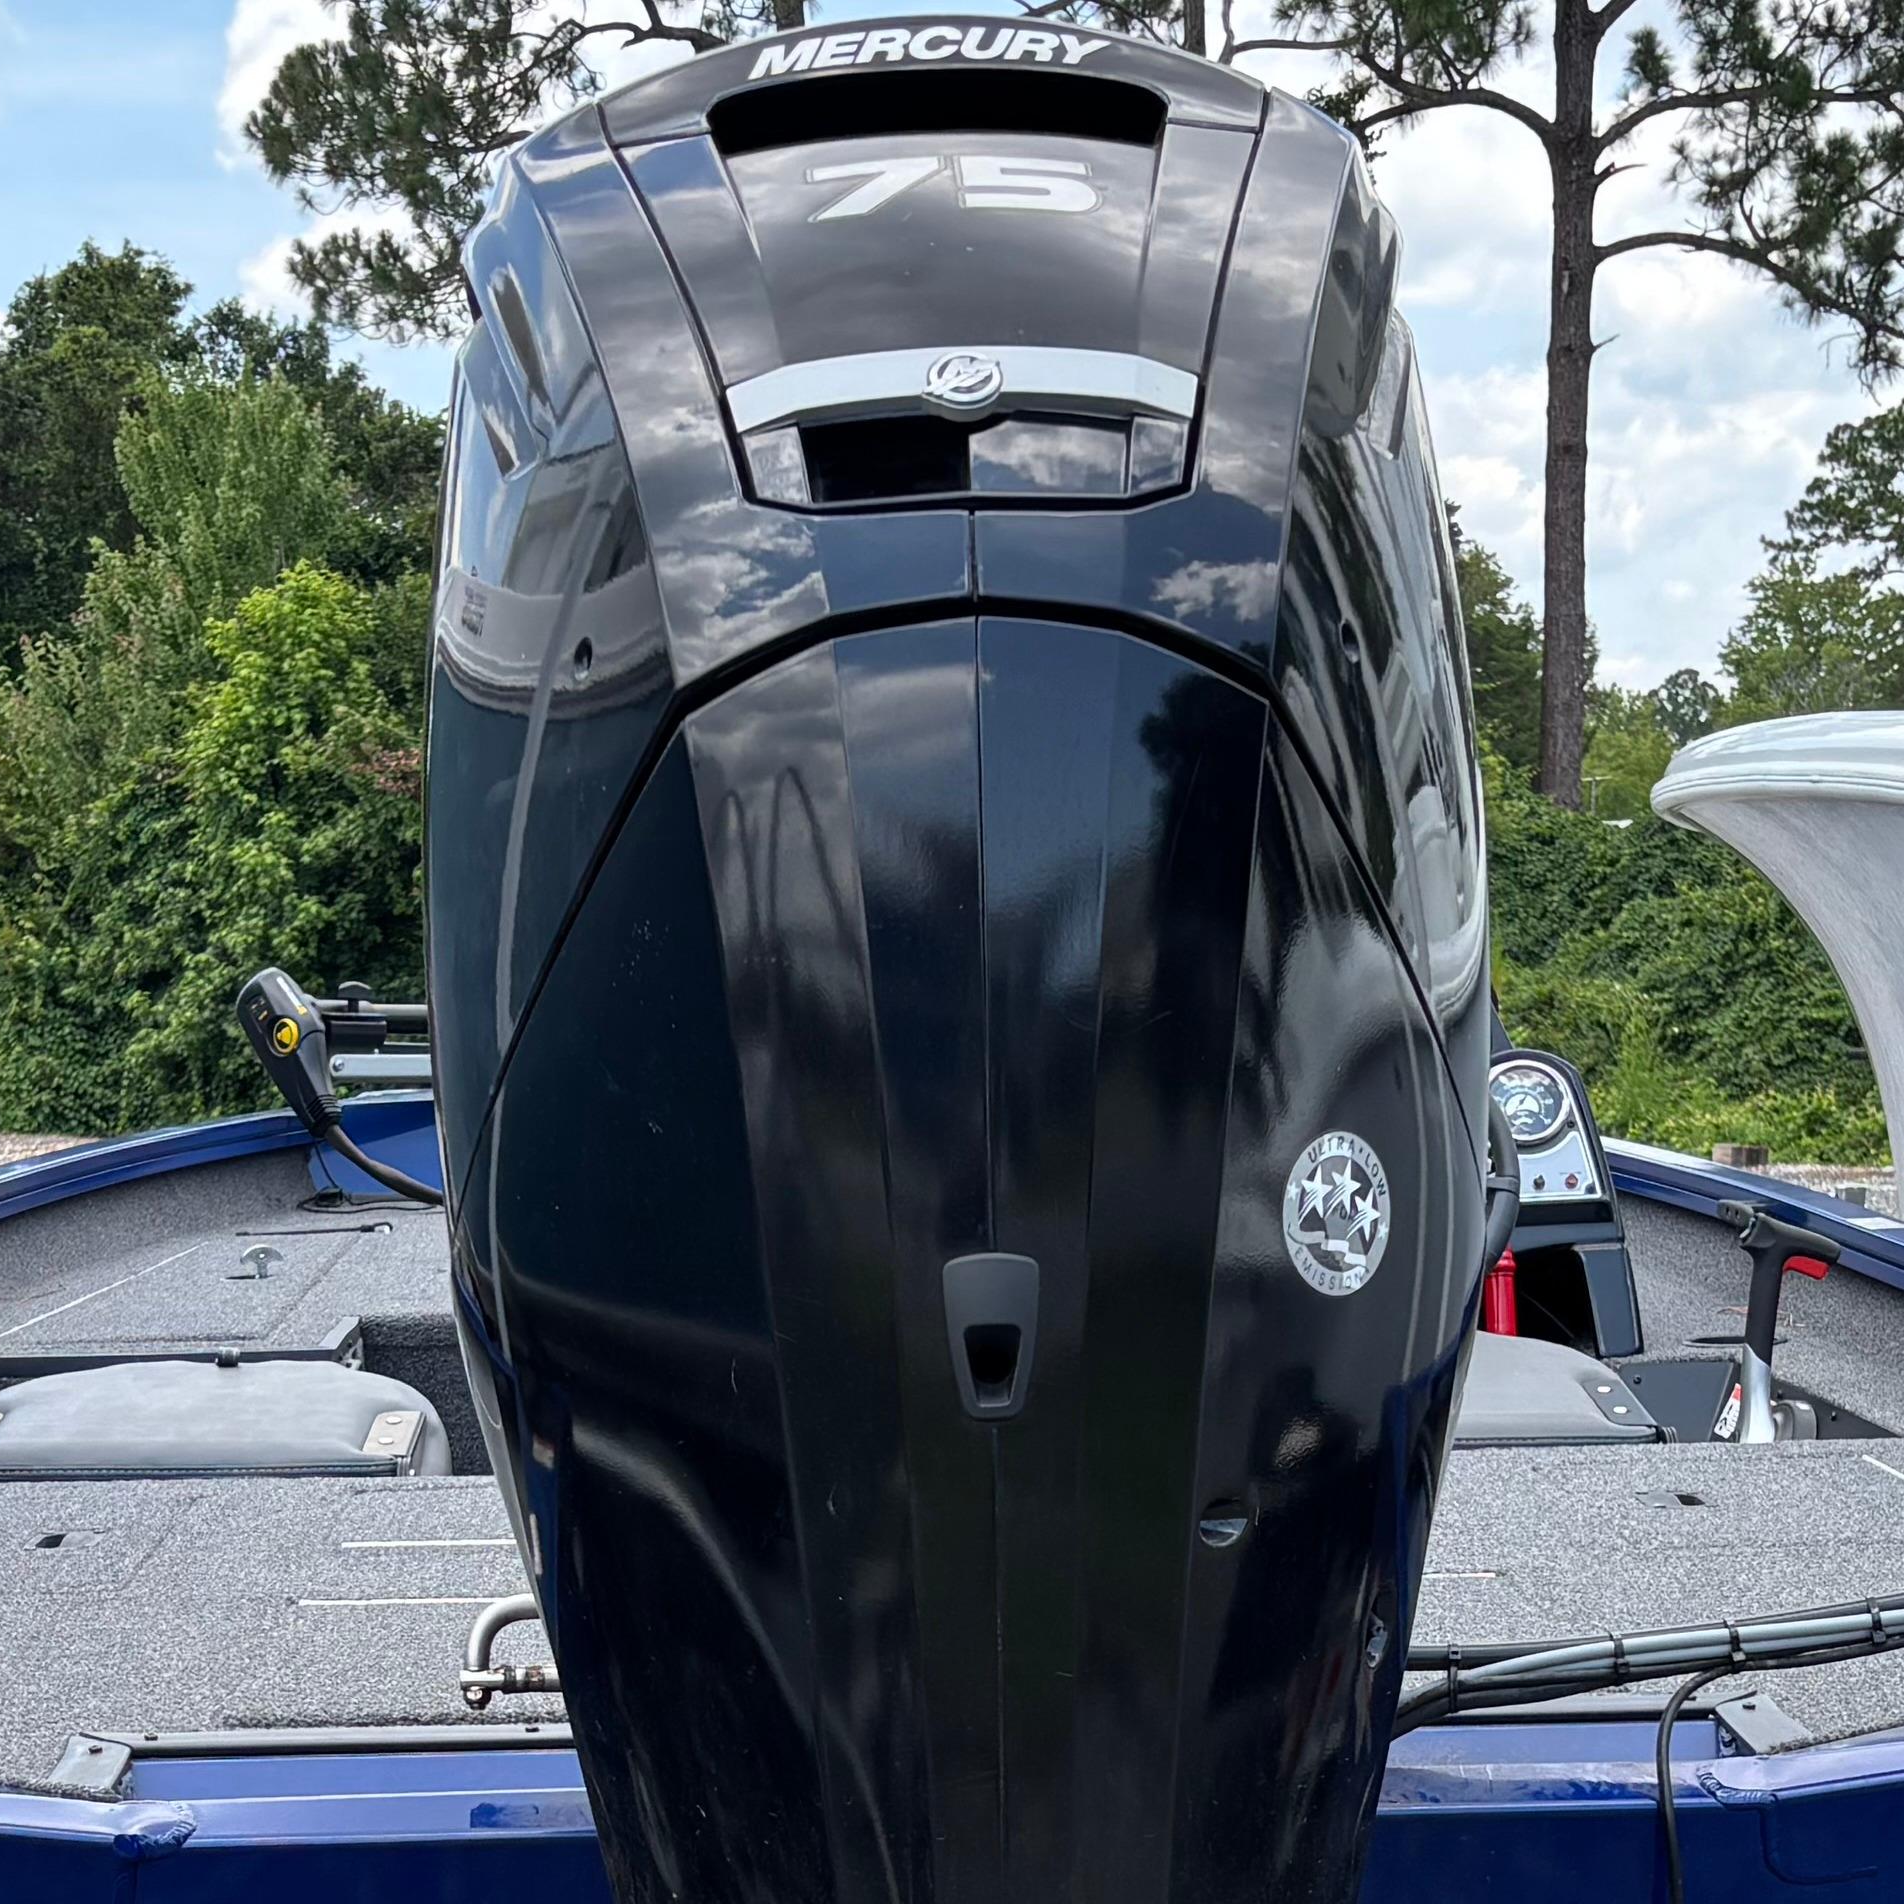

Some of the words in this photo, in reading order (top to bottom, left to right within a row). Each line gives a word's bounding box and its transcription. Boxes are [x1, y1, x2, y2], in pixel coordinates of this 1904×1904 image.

[747, 25, 1112, 81] MERCURY
[804, 154, 1102, 223] 75
[1307, 1134, 1355, 1164] ULTRA
[1363, 1151, 1387, 1197] LOW
[1293, 1244, 1370, 1291] EMISSION
